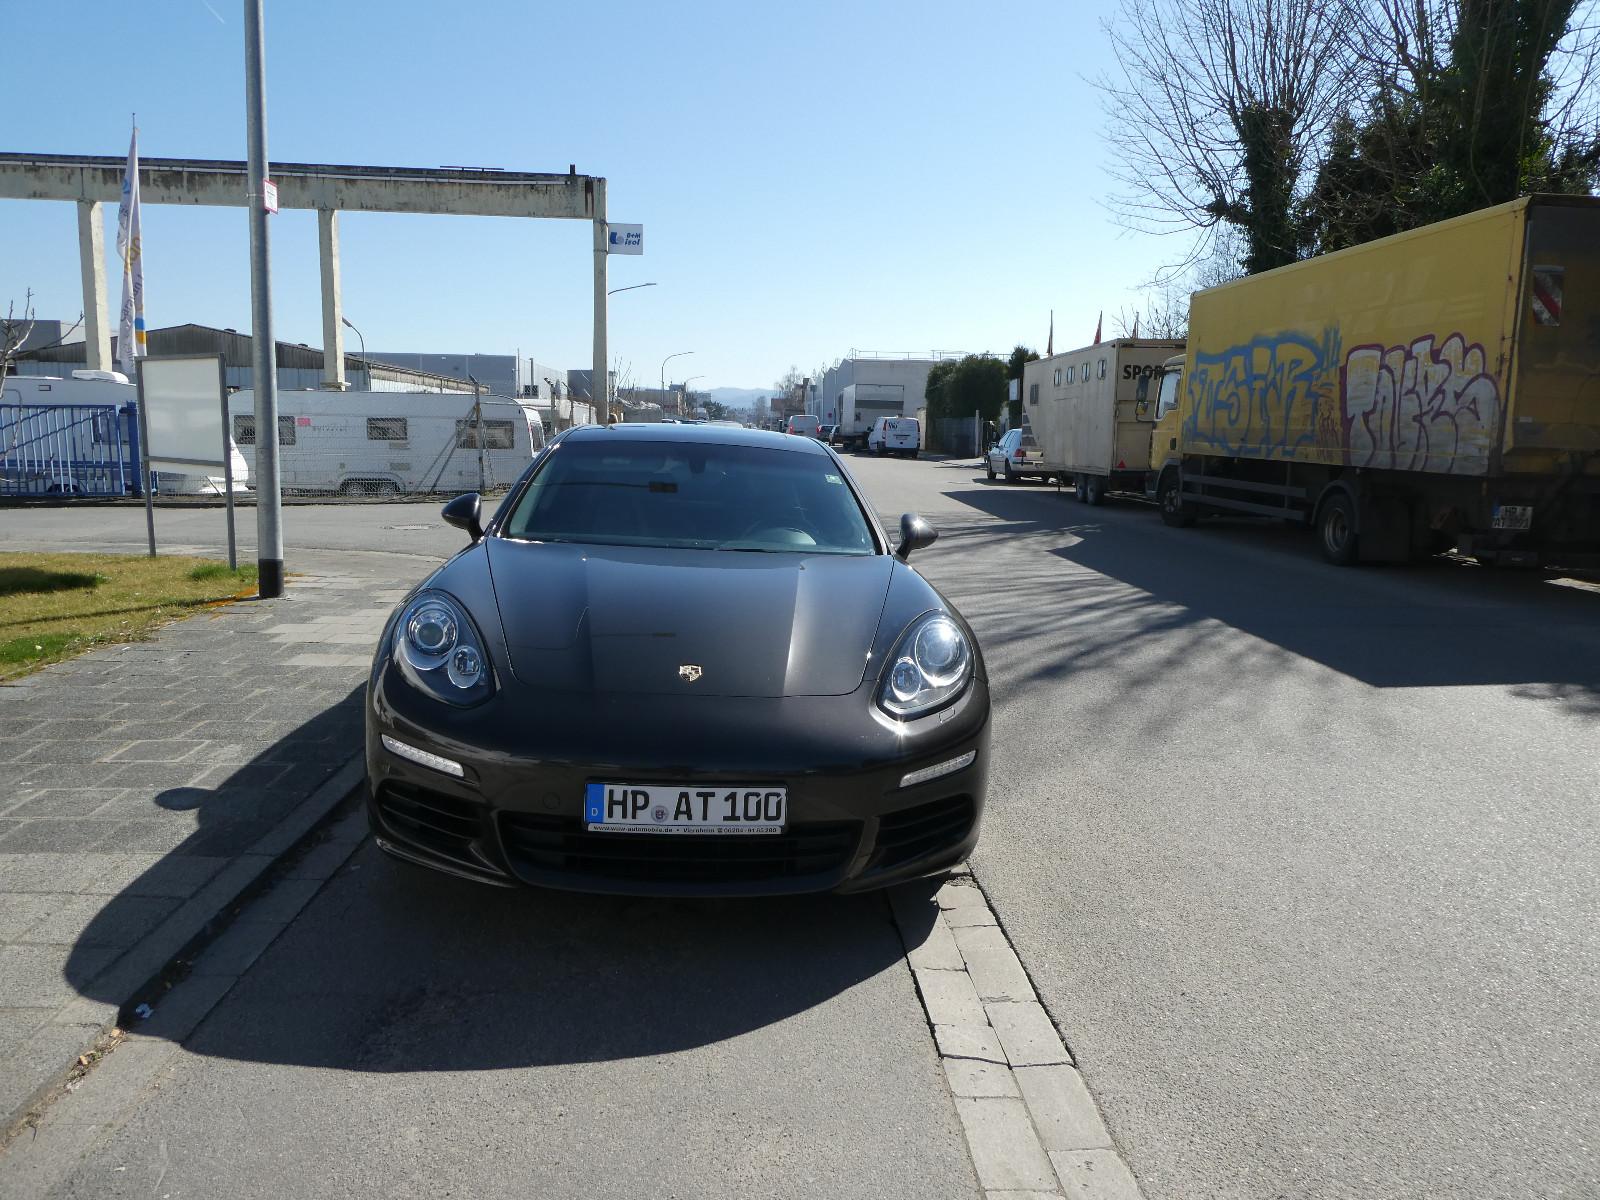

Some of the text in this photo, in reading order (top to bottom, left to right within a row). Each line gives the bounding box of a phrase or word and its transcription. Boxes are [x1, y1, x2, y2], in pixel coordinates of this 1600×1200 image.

[607, 789, 650, 819] HP
[673, 791, 716, 821] AT
[722, 791, 782, 822] 100
